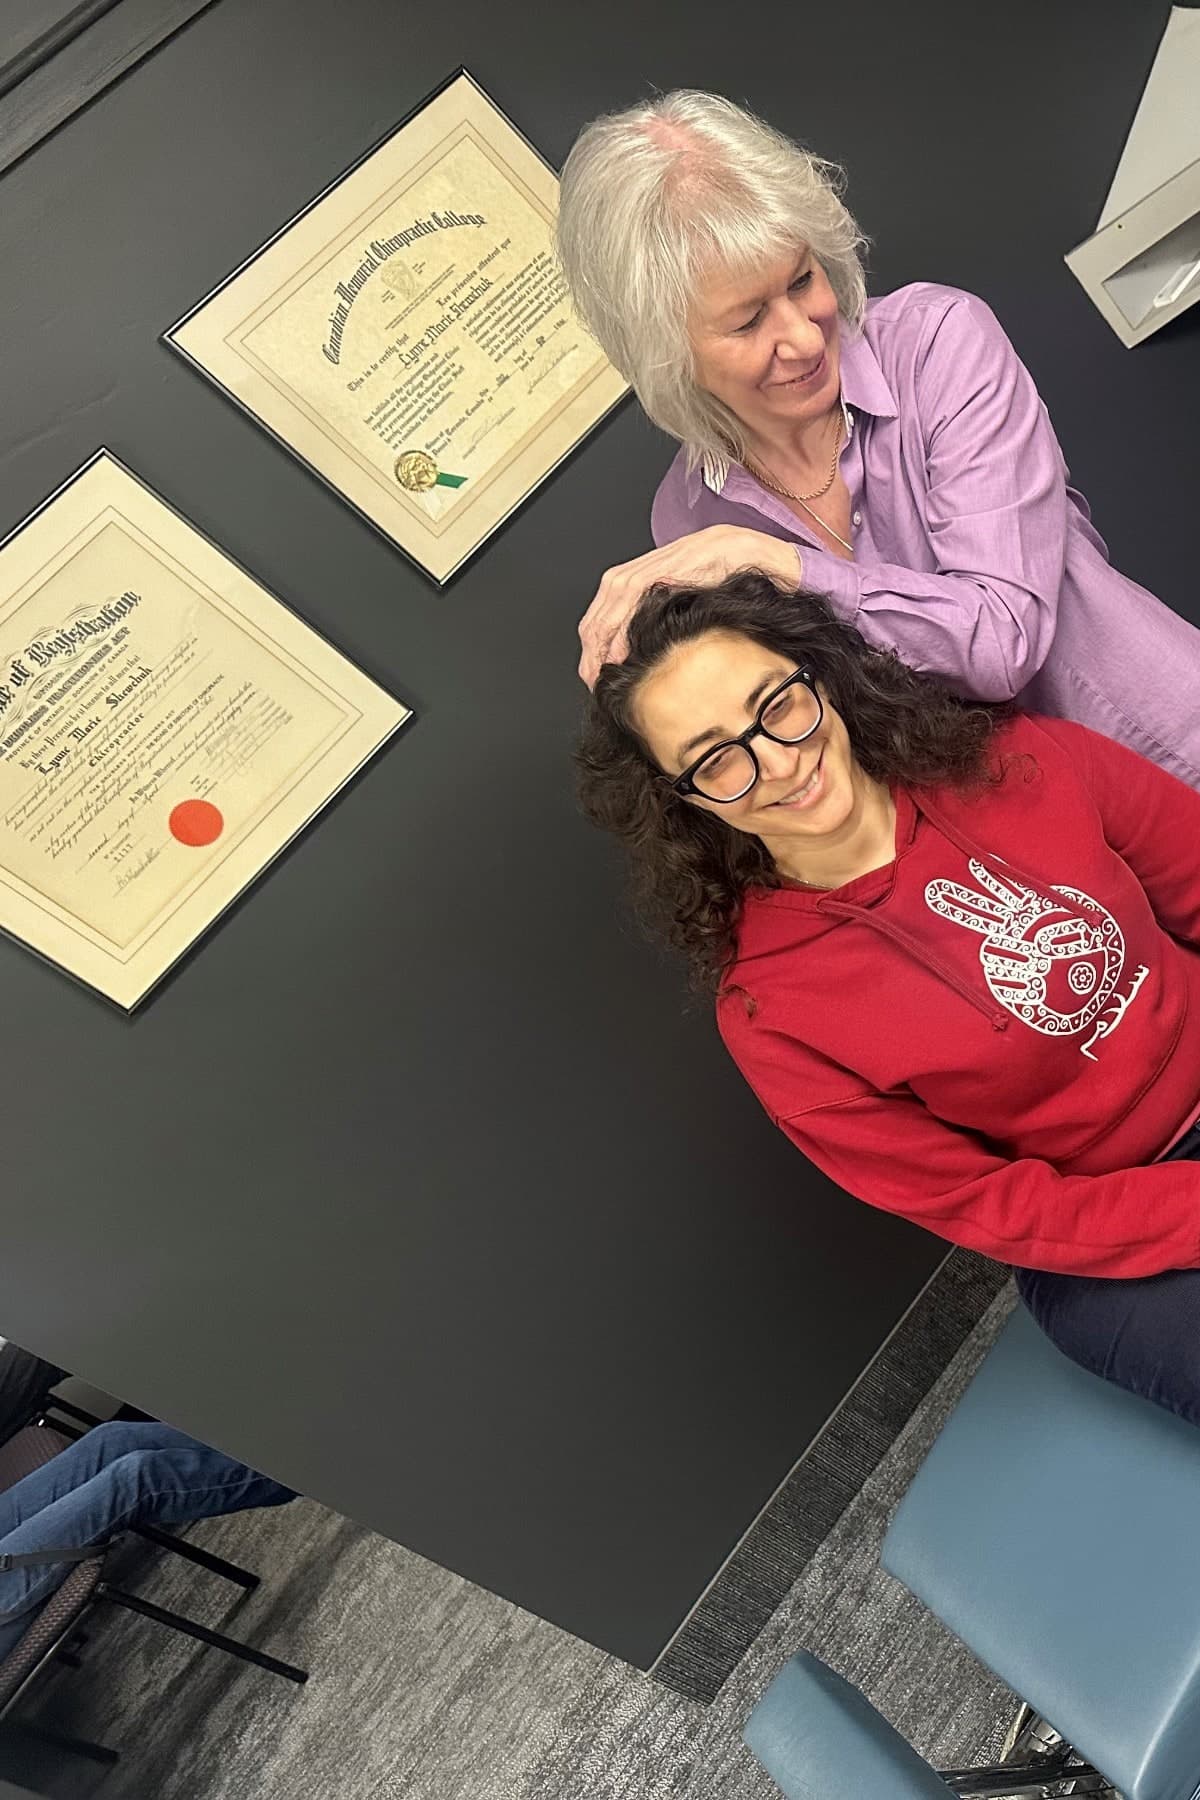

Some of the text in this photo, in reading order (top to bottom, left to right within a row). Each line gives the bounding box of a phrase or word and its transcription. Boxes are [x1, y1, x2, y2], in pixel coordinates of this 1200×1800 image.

[369, 218, 437, 260] Chiropractic
[430, 210, 487, 229] College
[333, 250, 380, 308] Memorial
[435, 237, 511, 307] Les présentes attestent que
[322, 302, 349, 364] Canadian
[398, 338, 429, 369] Lynne
[423, 314, 455, 345] Marie
[448, 277, 493, 320] Shewchuk
[346, 332, 409, 391] This is to certify that
[9, 659, 32, 687] of
[24, 592, 141, 667] Registration.
[4, 734, 34, 762] PROVINCE
[33, 726, 41, 734] OF
[41, 705, 64, 726] ONTARIO
[71, 672, 98, 698] DOMINION
[98, 663, 106, 672] OF
[107, 643, 128, 663] CANADA
[33, 746, 70, 775] Lynne
[67, 716, 101, 744] Marie
[88, 712, 144, 767] Chiropractor
